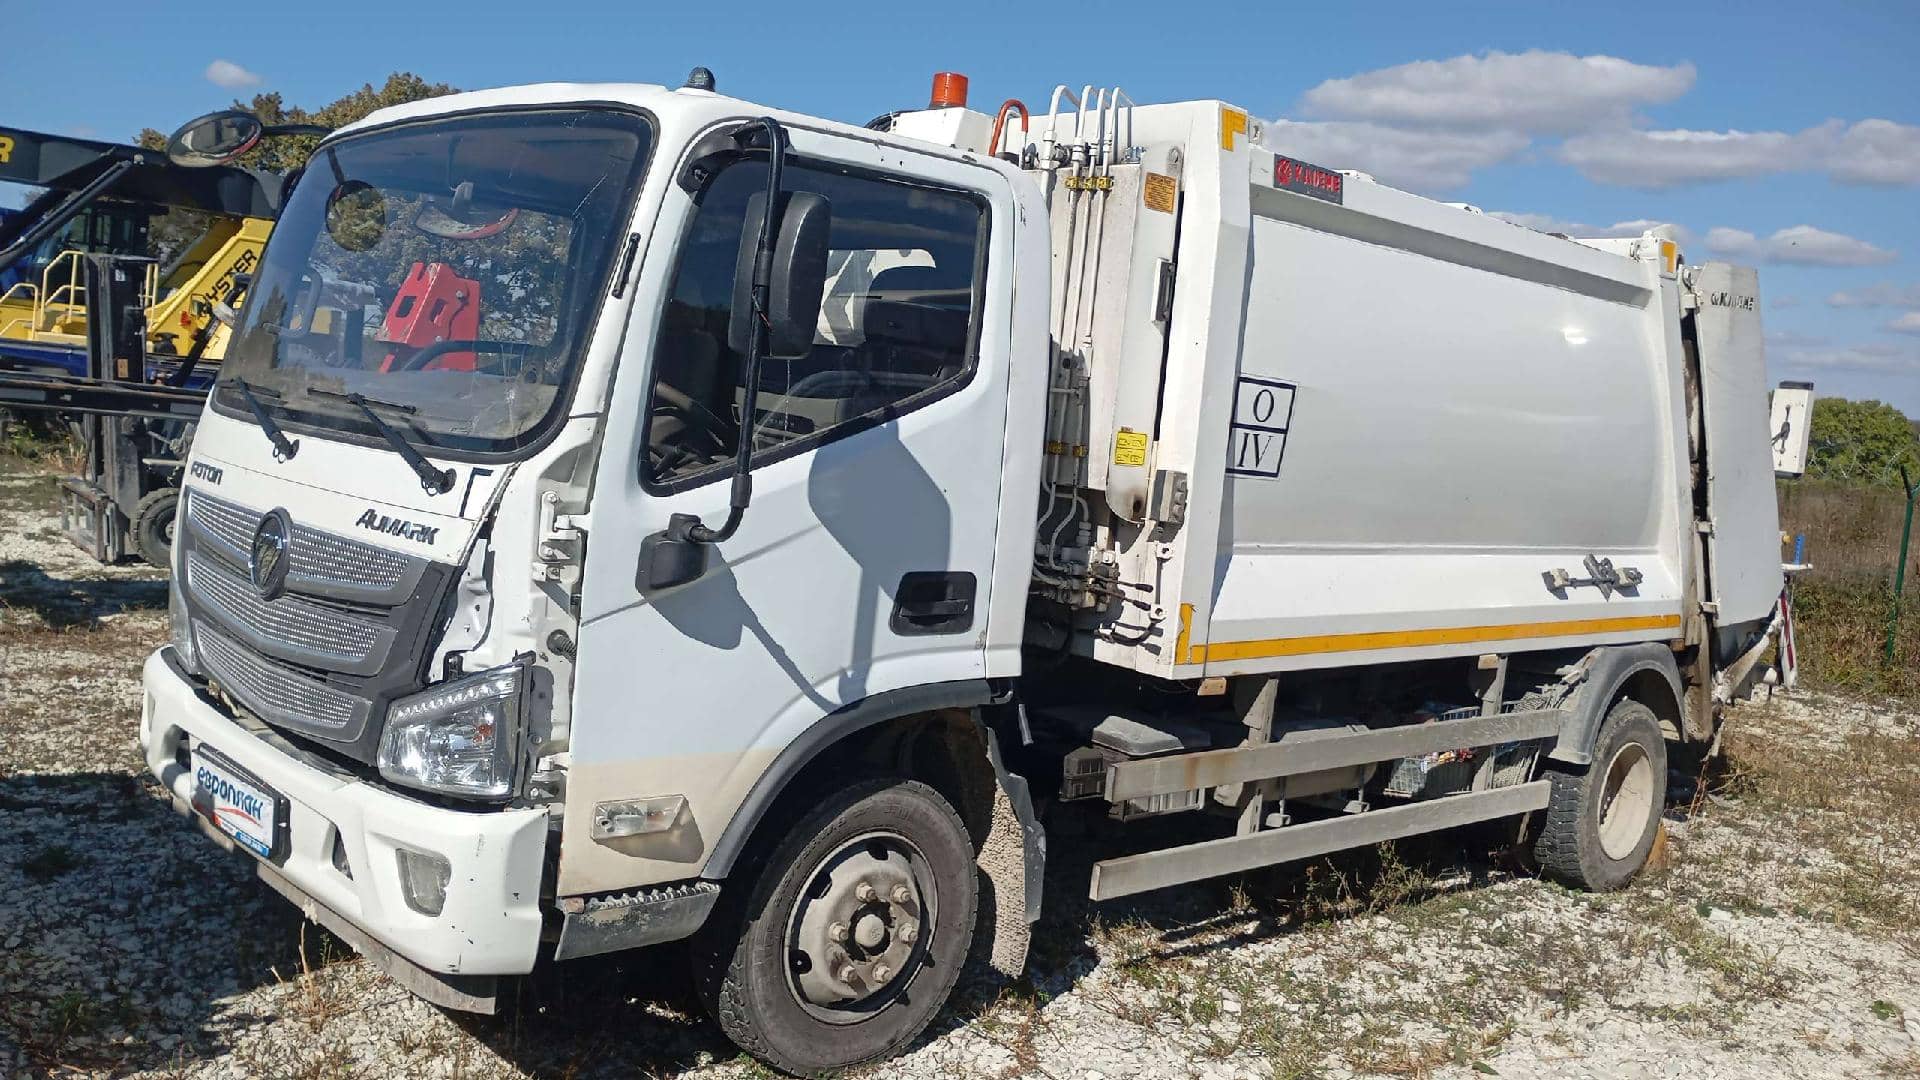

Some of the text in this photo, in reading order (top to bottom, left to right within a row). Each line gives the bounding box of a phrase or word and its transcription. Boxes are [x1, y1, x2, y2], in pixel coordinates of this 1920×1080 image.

[204, 248, 257, 302] YSTER
[1237, 432, 1274, 468] IV
[355, 508, 440, 545] AUMARK
